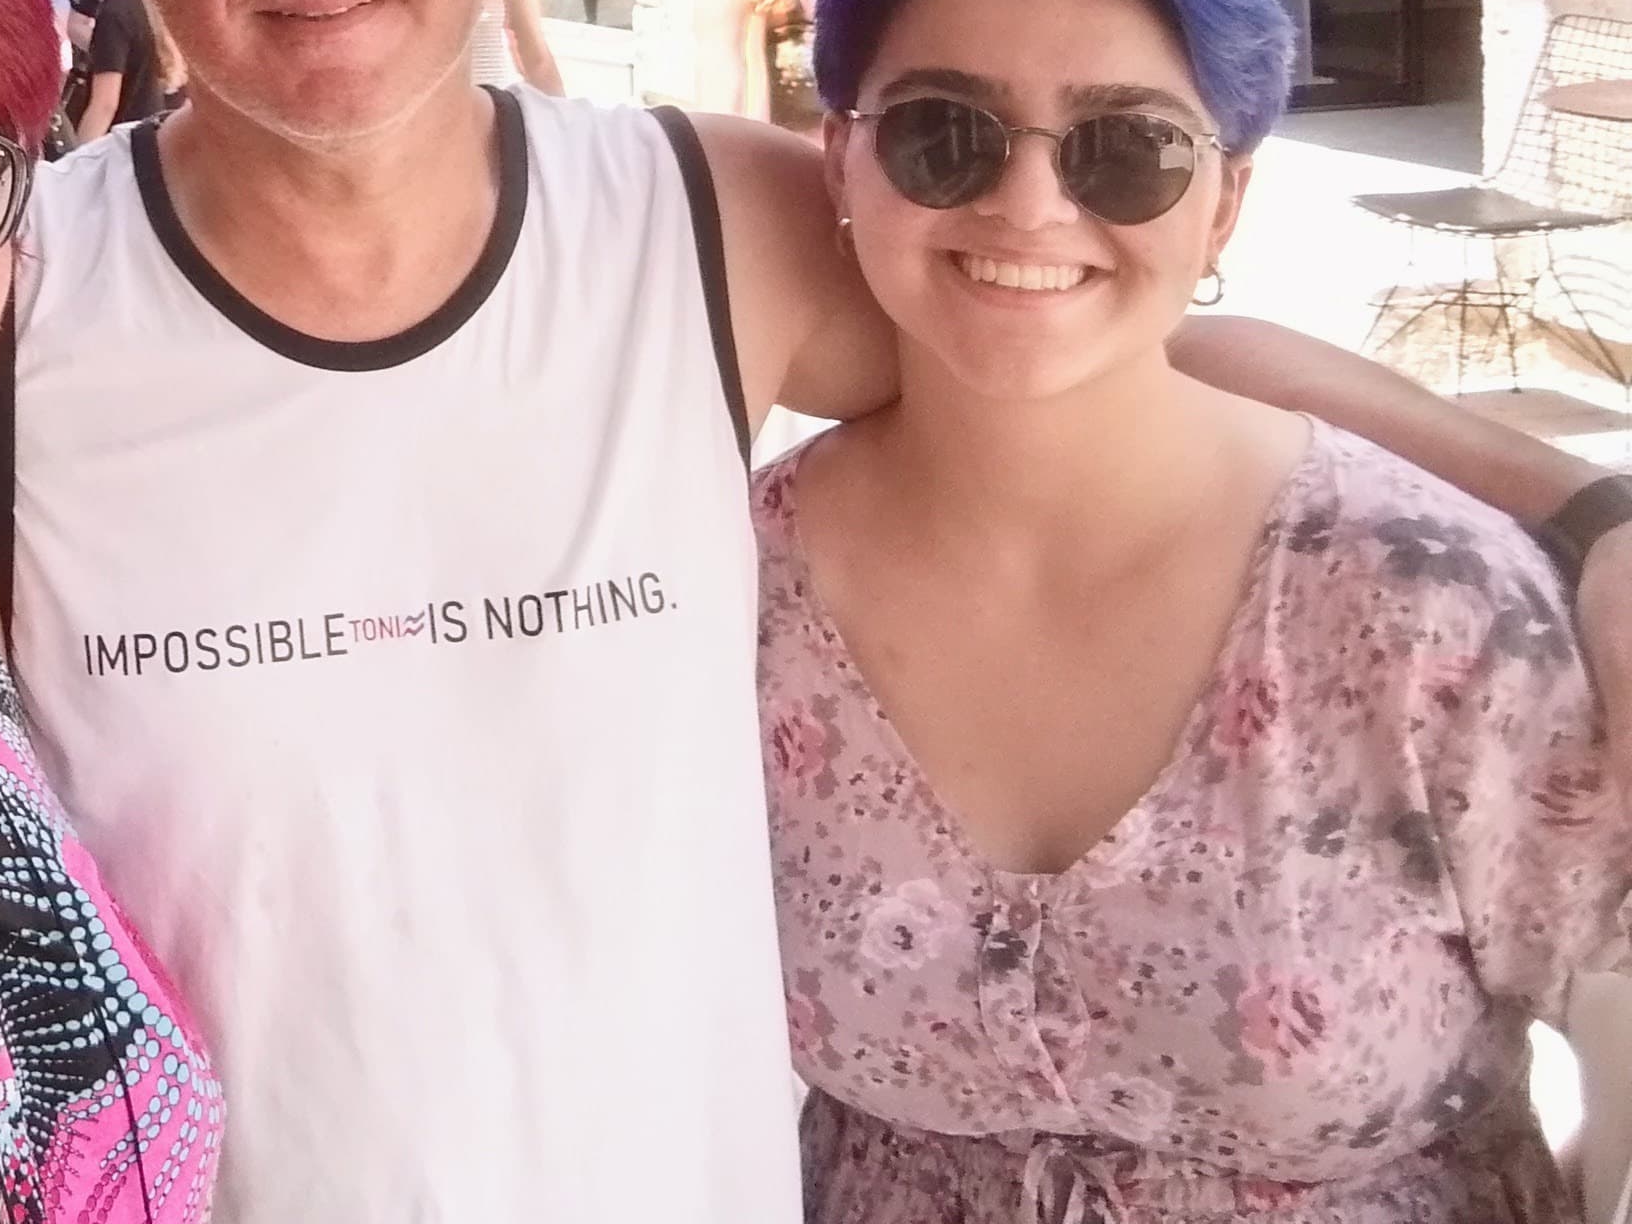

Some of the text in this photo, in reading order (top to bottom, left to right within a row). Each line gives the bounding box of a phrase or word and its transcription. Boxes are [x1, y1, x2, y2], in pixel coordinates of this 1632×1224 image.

[83, 571, 678, 677] IMPOSSIBLE TONI IS NOTHING.
